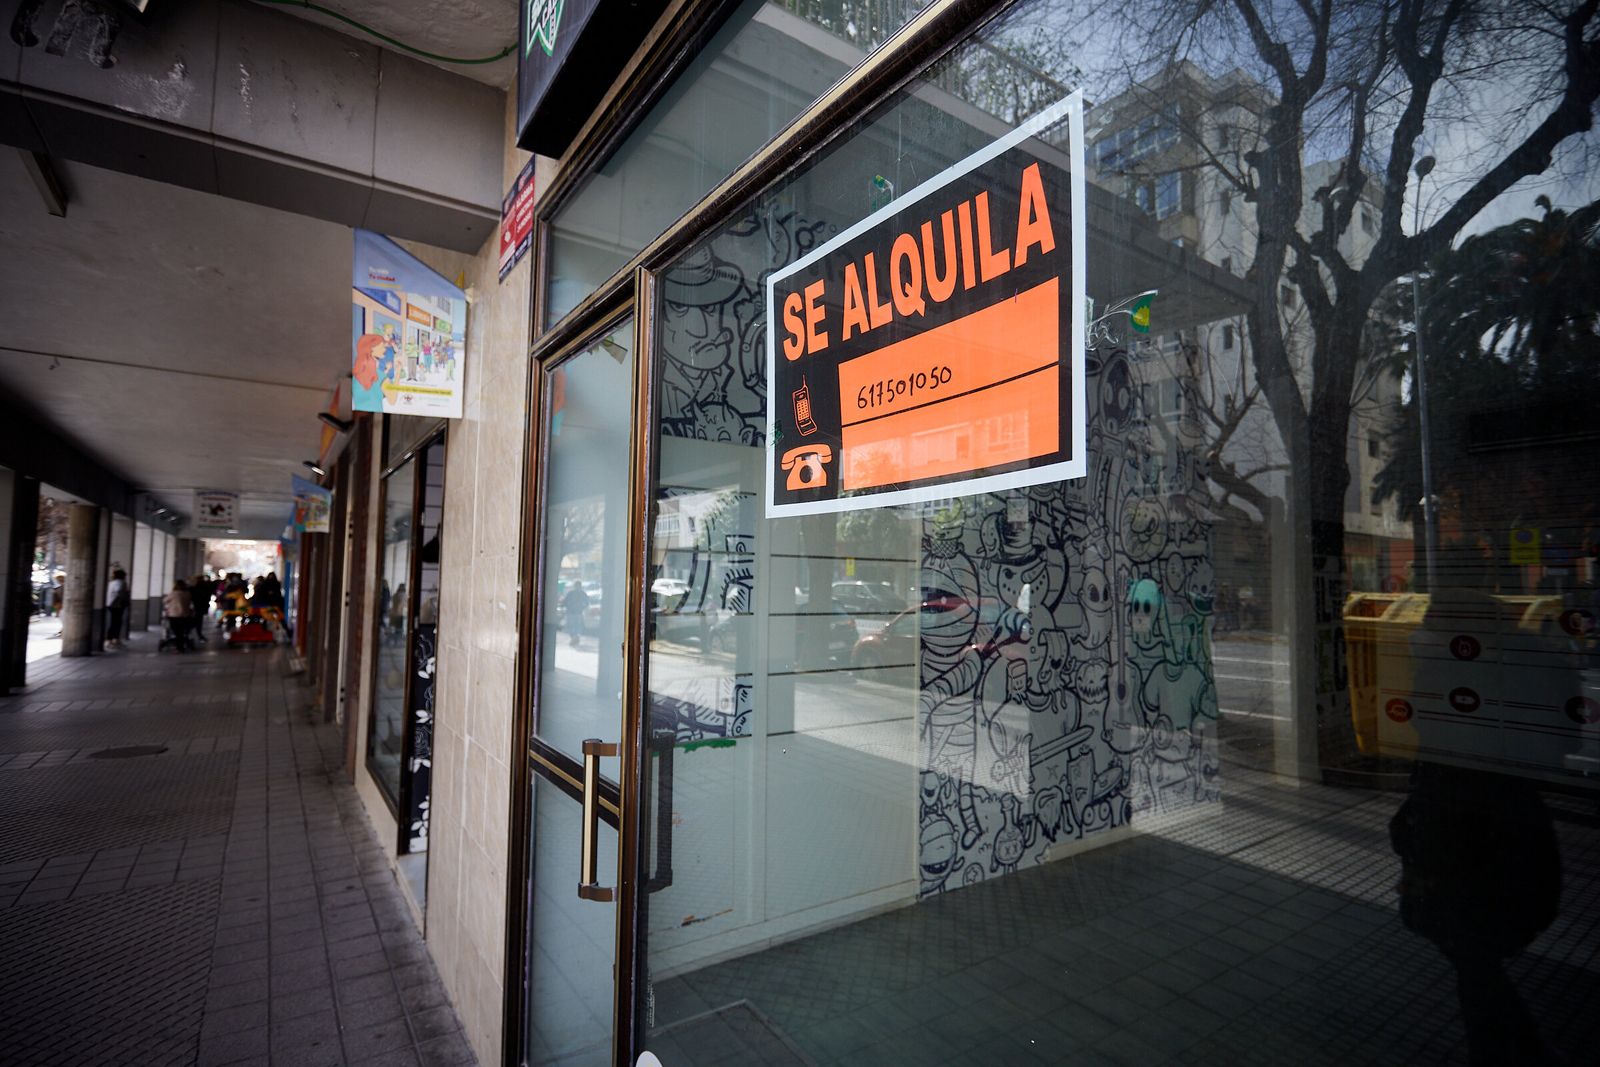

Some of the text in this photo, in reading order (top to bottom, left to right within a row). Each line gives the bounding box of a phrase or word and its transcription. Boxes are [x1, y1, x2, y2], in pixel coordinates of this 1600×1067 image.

[783, 162, 1056, 361] SE ALQUILA
[857, 366, 952, 409] 617501050
